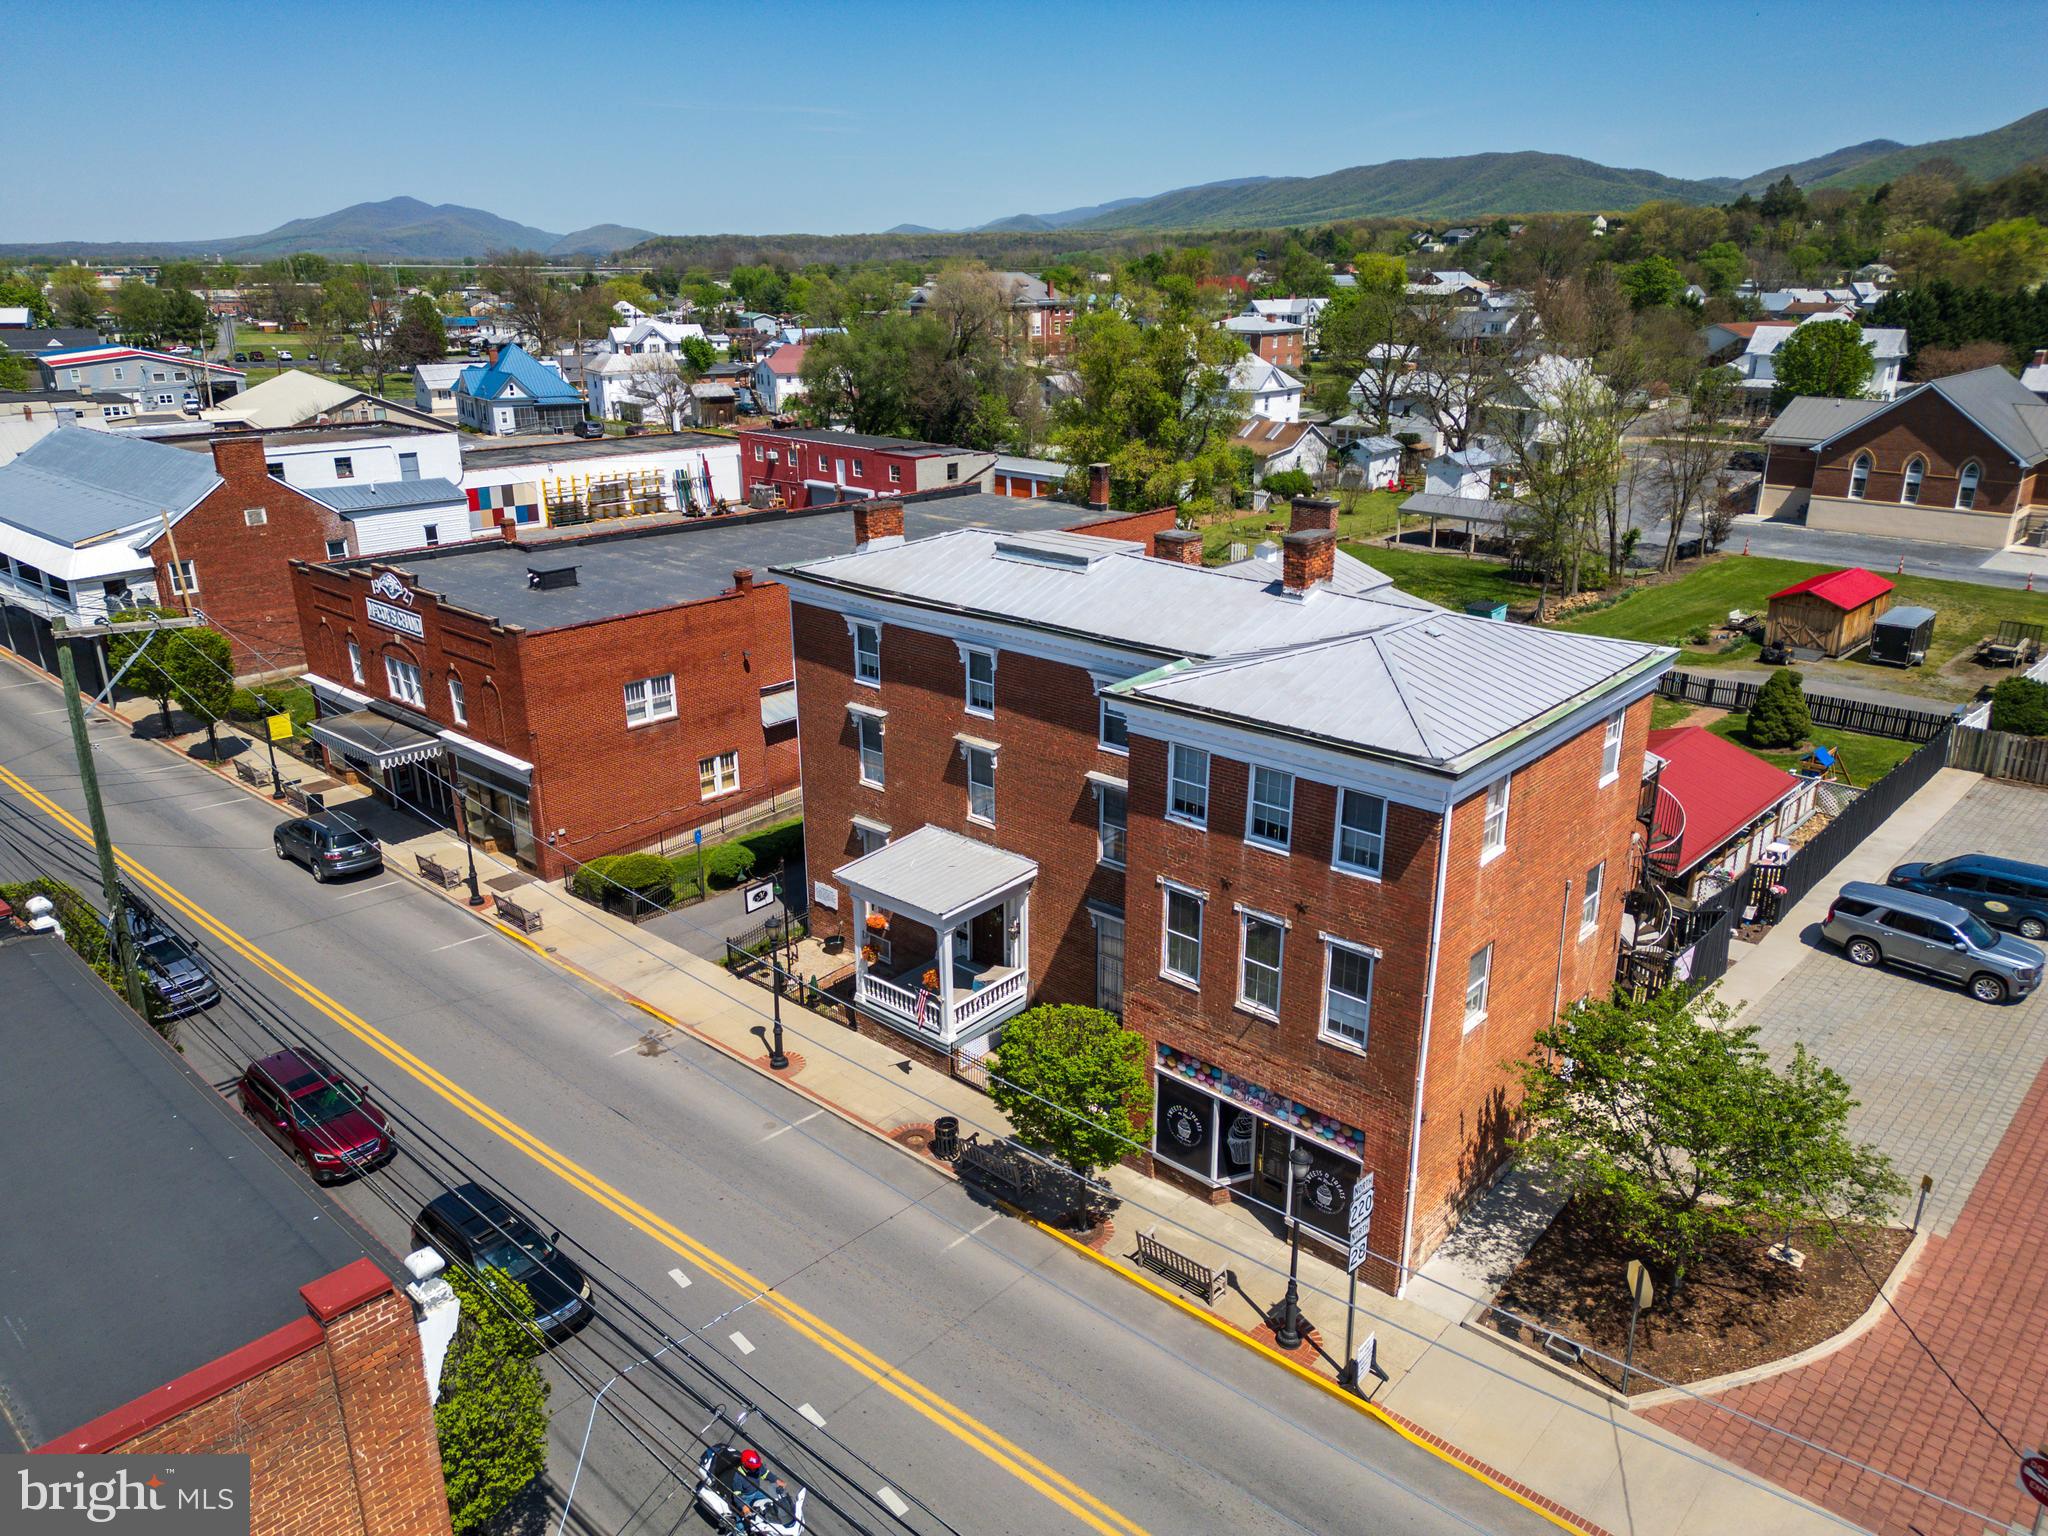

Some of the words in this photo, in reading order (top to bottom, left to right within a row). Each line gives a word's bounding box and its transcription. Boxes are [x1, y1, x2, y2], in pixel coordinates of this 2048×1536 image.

[1354, 1177, 1373, 1195] NORTH
[1351, 1194, 1372, 1223] 220
[1351, 1224, 1369, 1241] NORTH
[1350, 1242, 1366, 1267] 28
